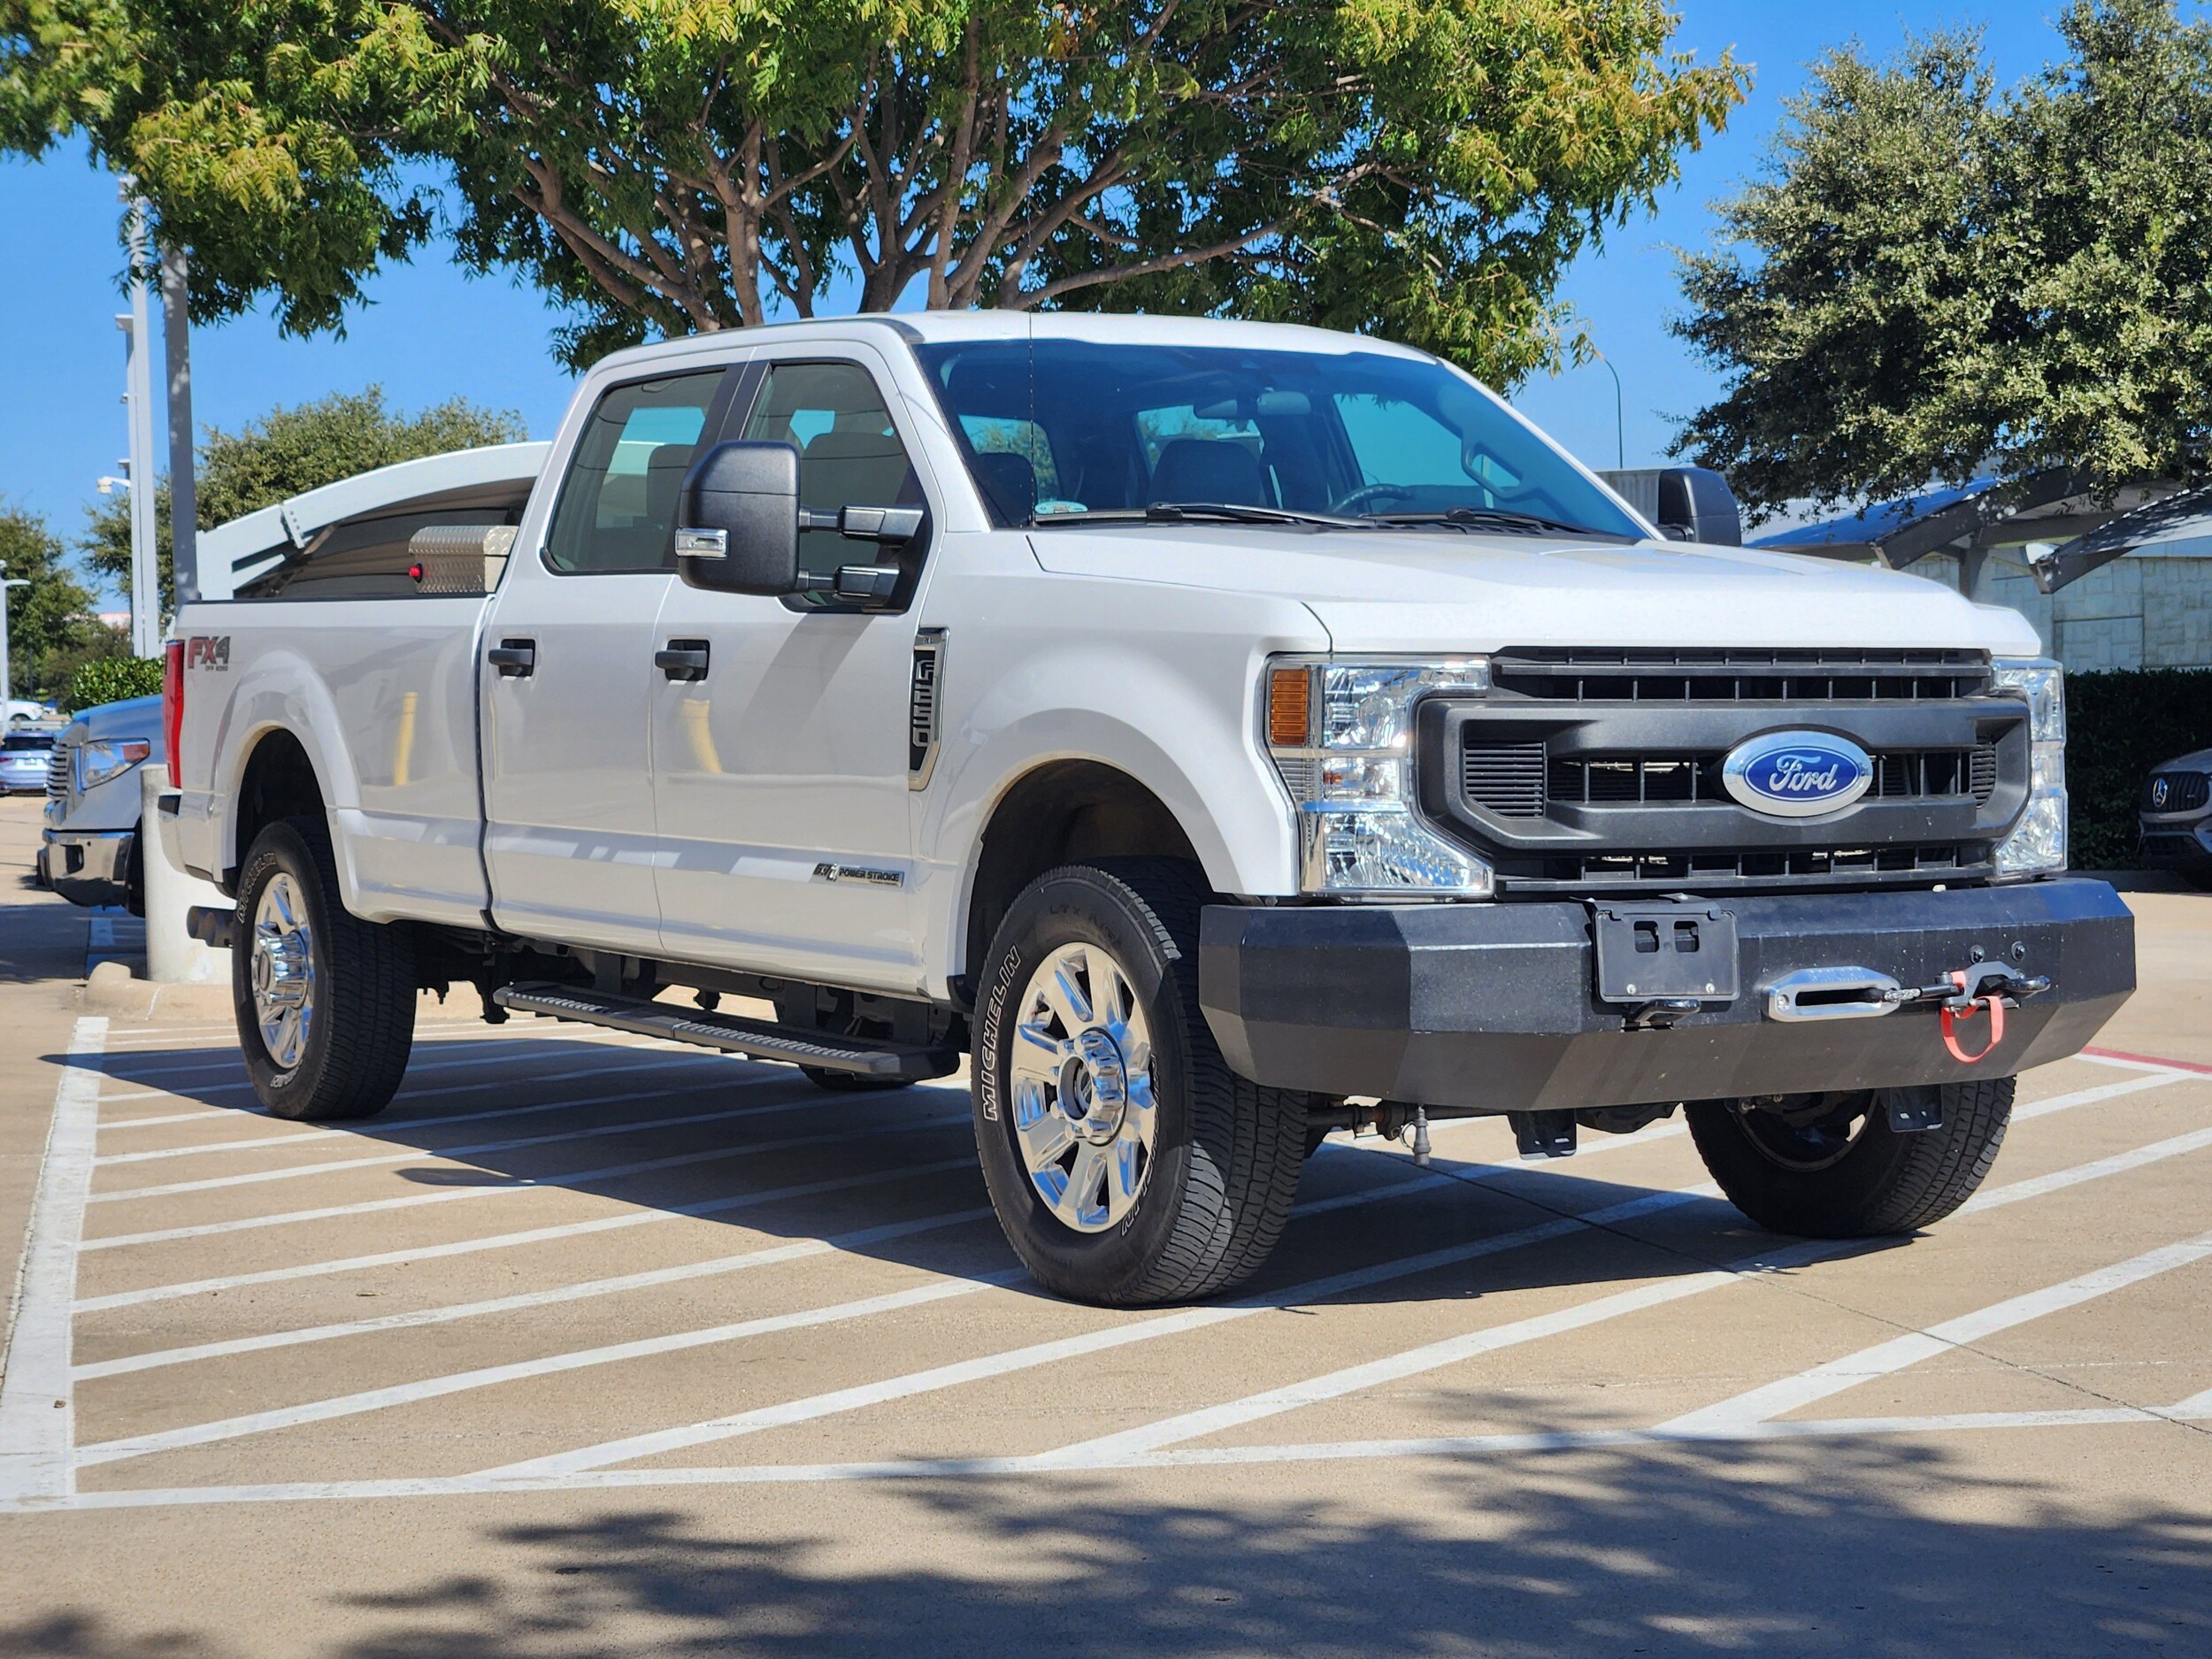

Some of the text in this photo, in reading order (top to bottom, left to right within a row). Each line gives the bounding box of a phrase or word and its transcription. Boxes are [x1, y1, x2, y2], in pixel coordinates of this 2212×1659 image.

[188, 636, 231, 669] FX4
[1769, 754, 1839, 791] Ford
[236, 852, 277, 925] MICHELIN
[838, 868, 866, 879] POWER
[866, 871, 900, 882] STROKE
[981, 945, 1021, 1122] MICHELIN
